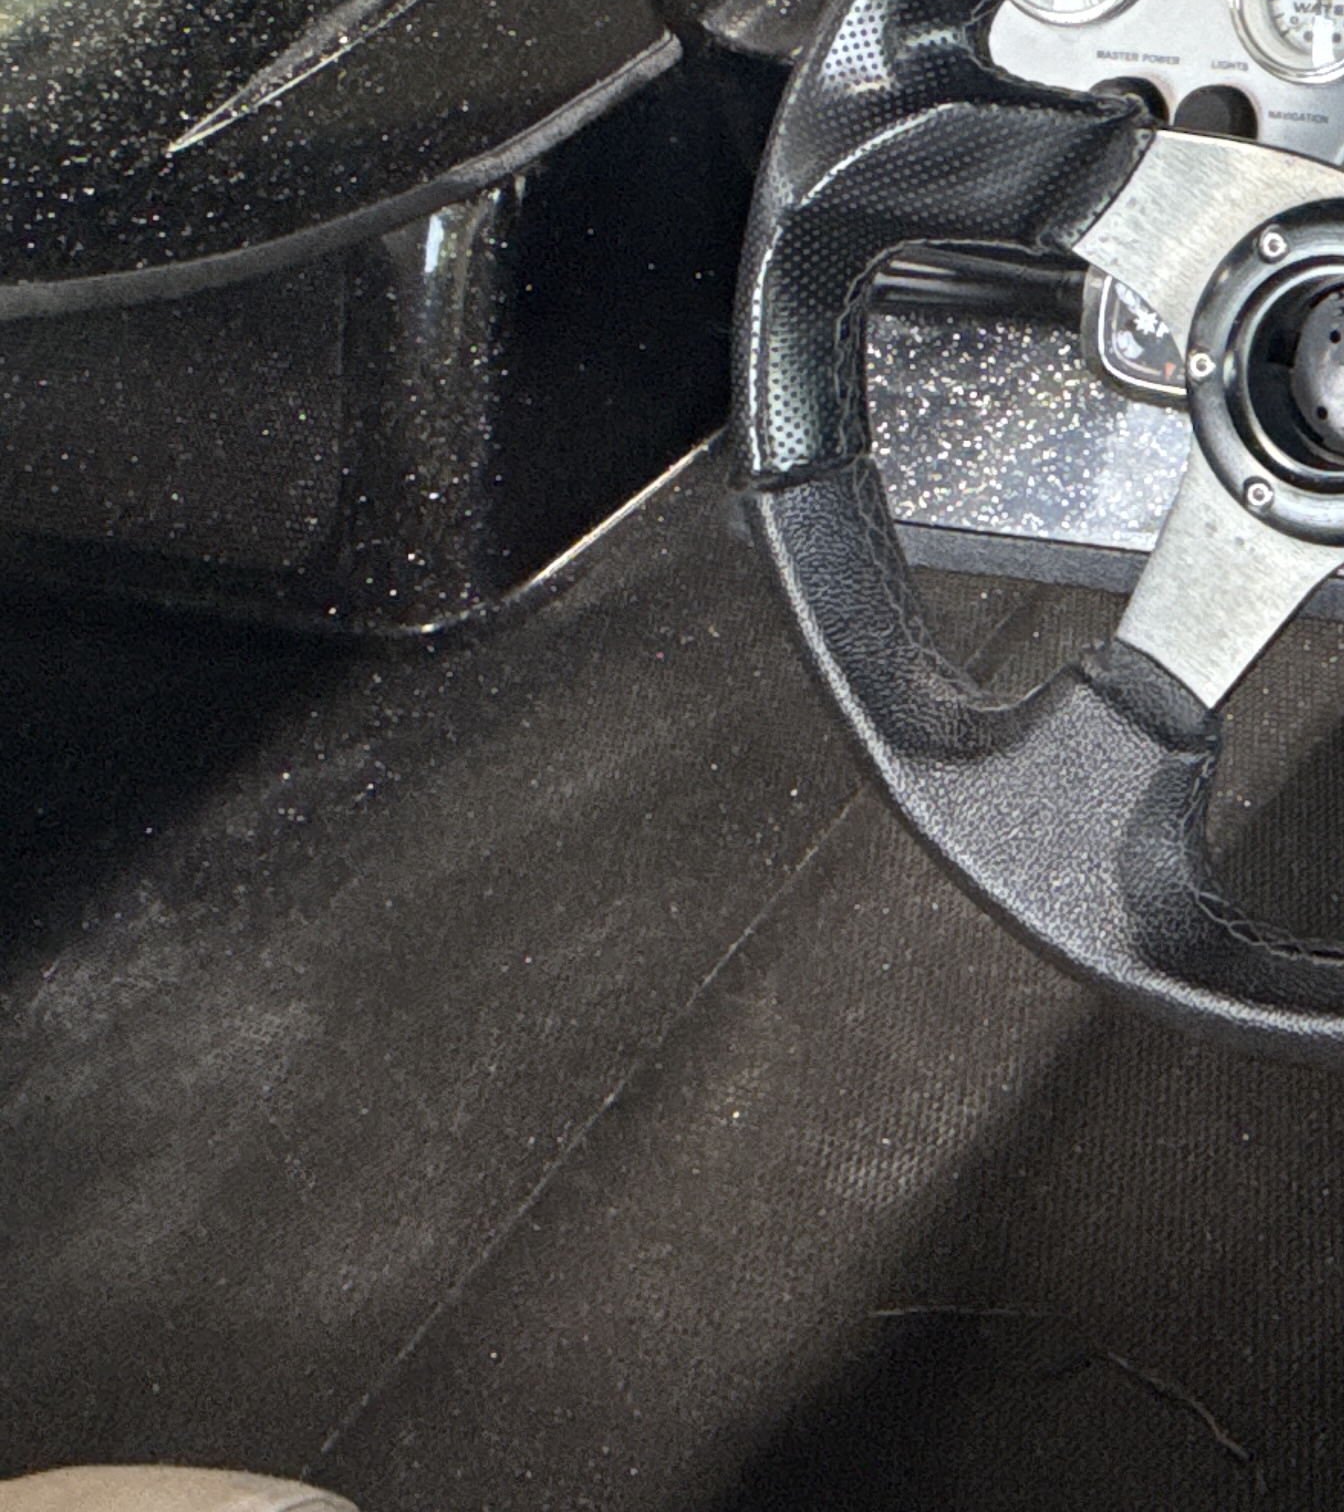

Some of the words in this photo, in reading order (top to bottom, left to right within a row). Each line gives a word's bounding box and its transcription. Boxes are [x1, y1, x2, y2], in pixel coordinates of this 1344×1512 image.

[1097, 50, 1139, 61] MASTER
[1142, 53, 1181, 65] POWER
[1211, 61, 1249, 72] LIGHTS
[1268, 110, 1329, 124] NAVIGATION
